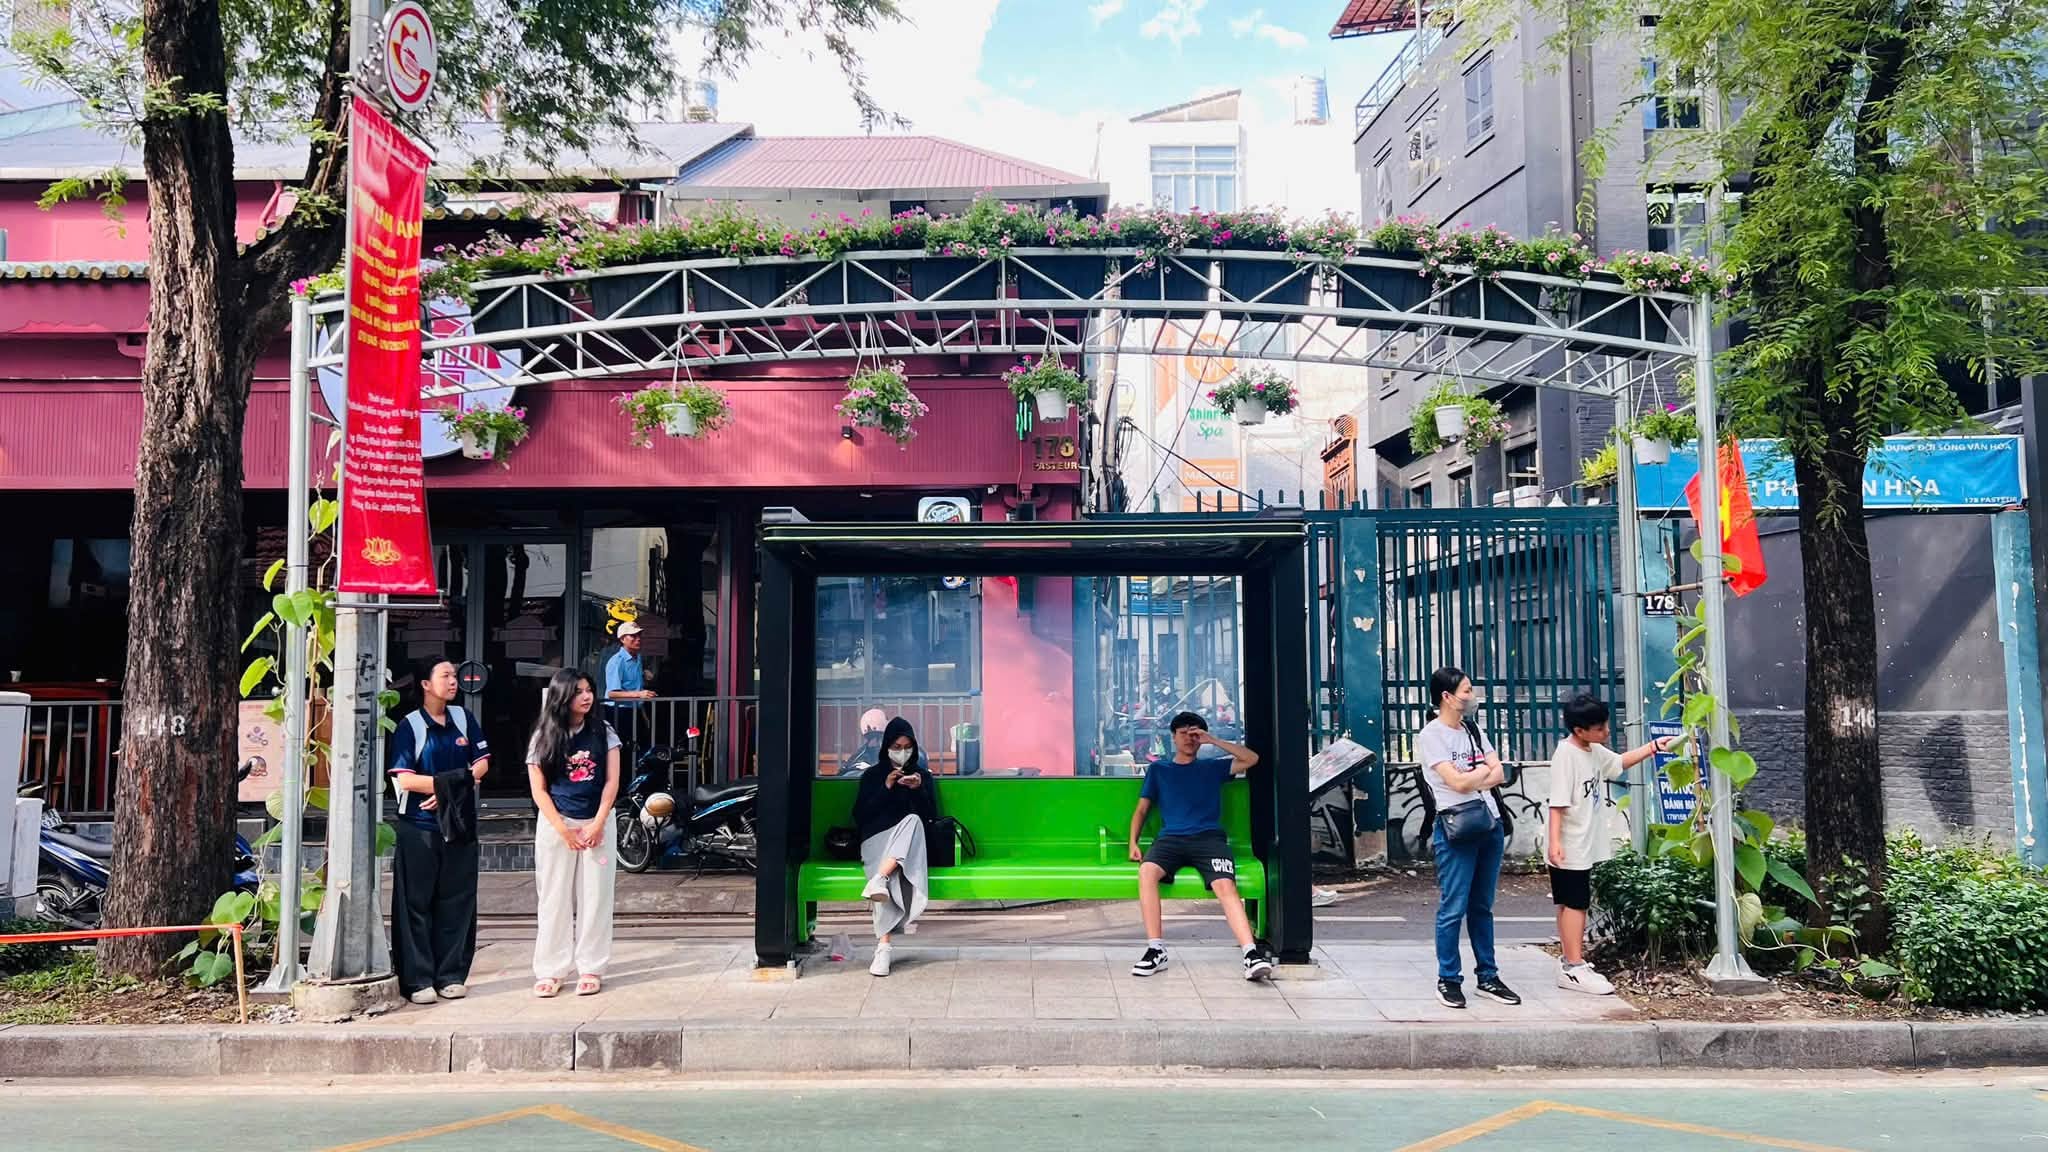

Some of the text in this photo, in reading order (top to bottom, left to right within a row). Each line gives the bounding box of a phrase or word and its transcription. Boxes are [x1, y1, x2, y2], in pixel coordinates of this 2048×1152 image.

[1197, 421, 1223, 440] Spa
[1032, 436, 1075, 459] 178
[1034, 461, 1078, 472] PASTEUR
[1645, 595, 1675, 610] 178
